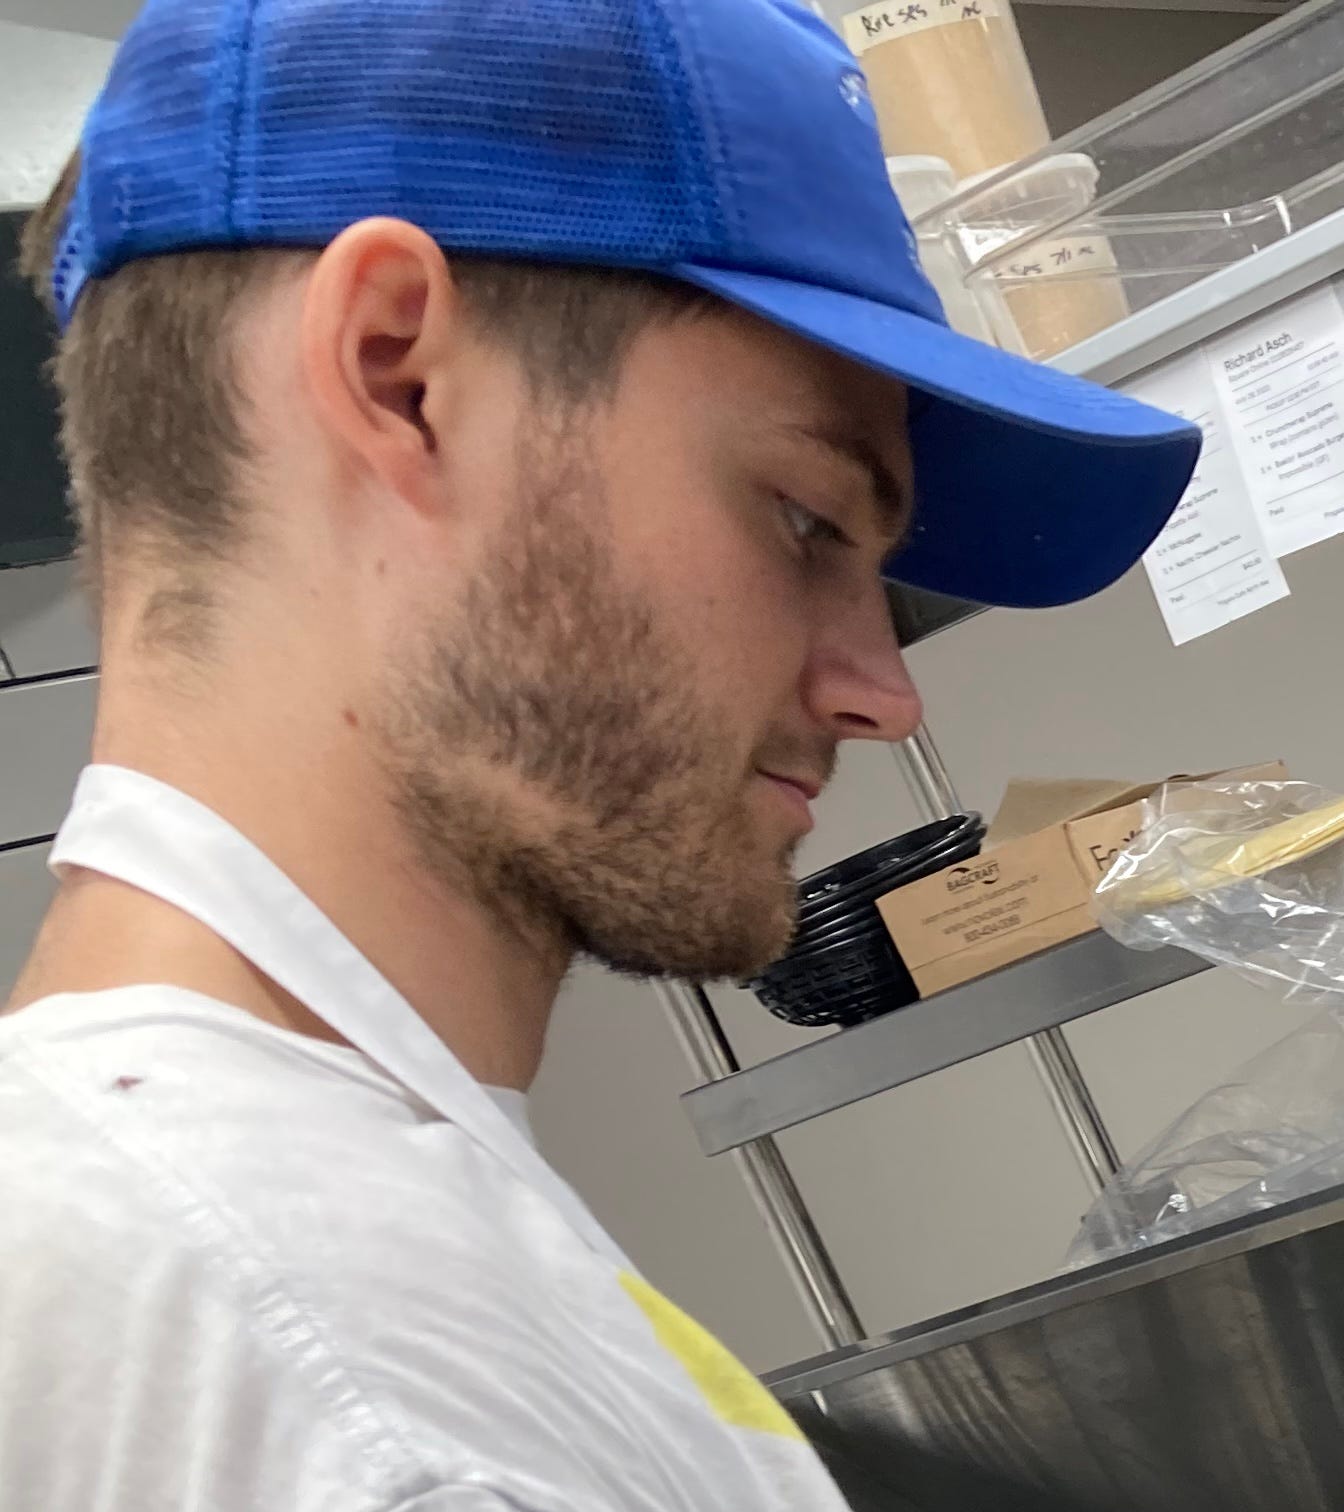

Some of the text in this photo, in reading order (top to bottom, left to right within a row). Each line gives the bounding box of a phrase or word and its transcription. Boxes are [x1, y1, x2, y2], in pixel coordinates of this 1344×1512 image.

[1223, 347, 1264, 371] Richard
[1265, 332, 1292, 353] Asch
[946, 863, 1000, 891] BAGCRAFT
